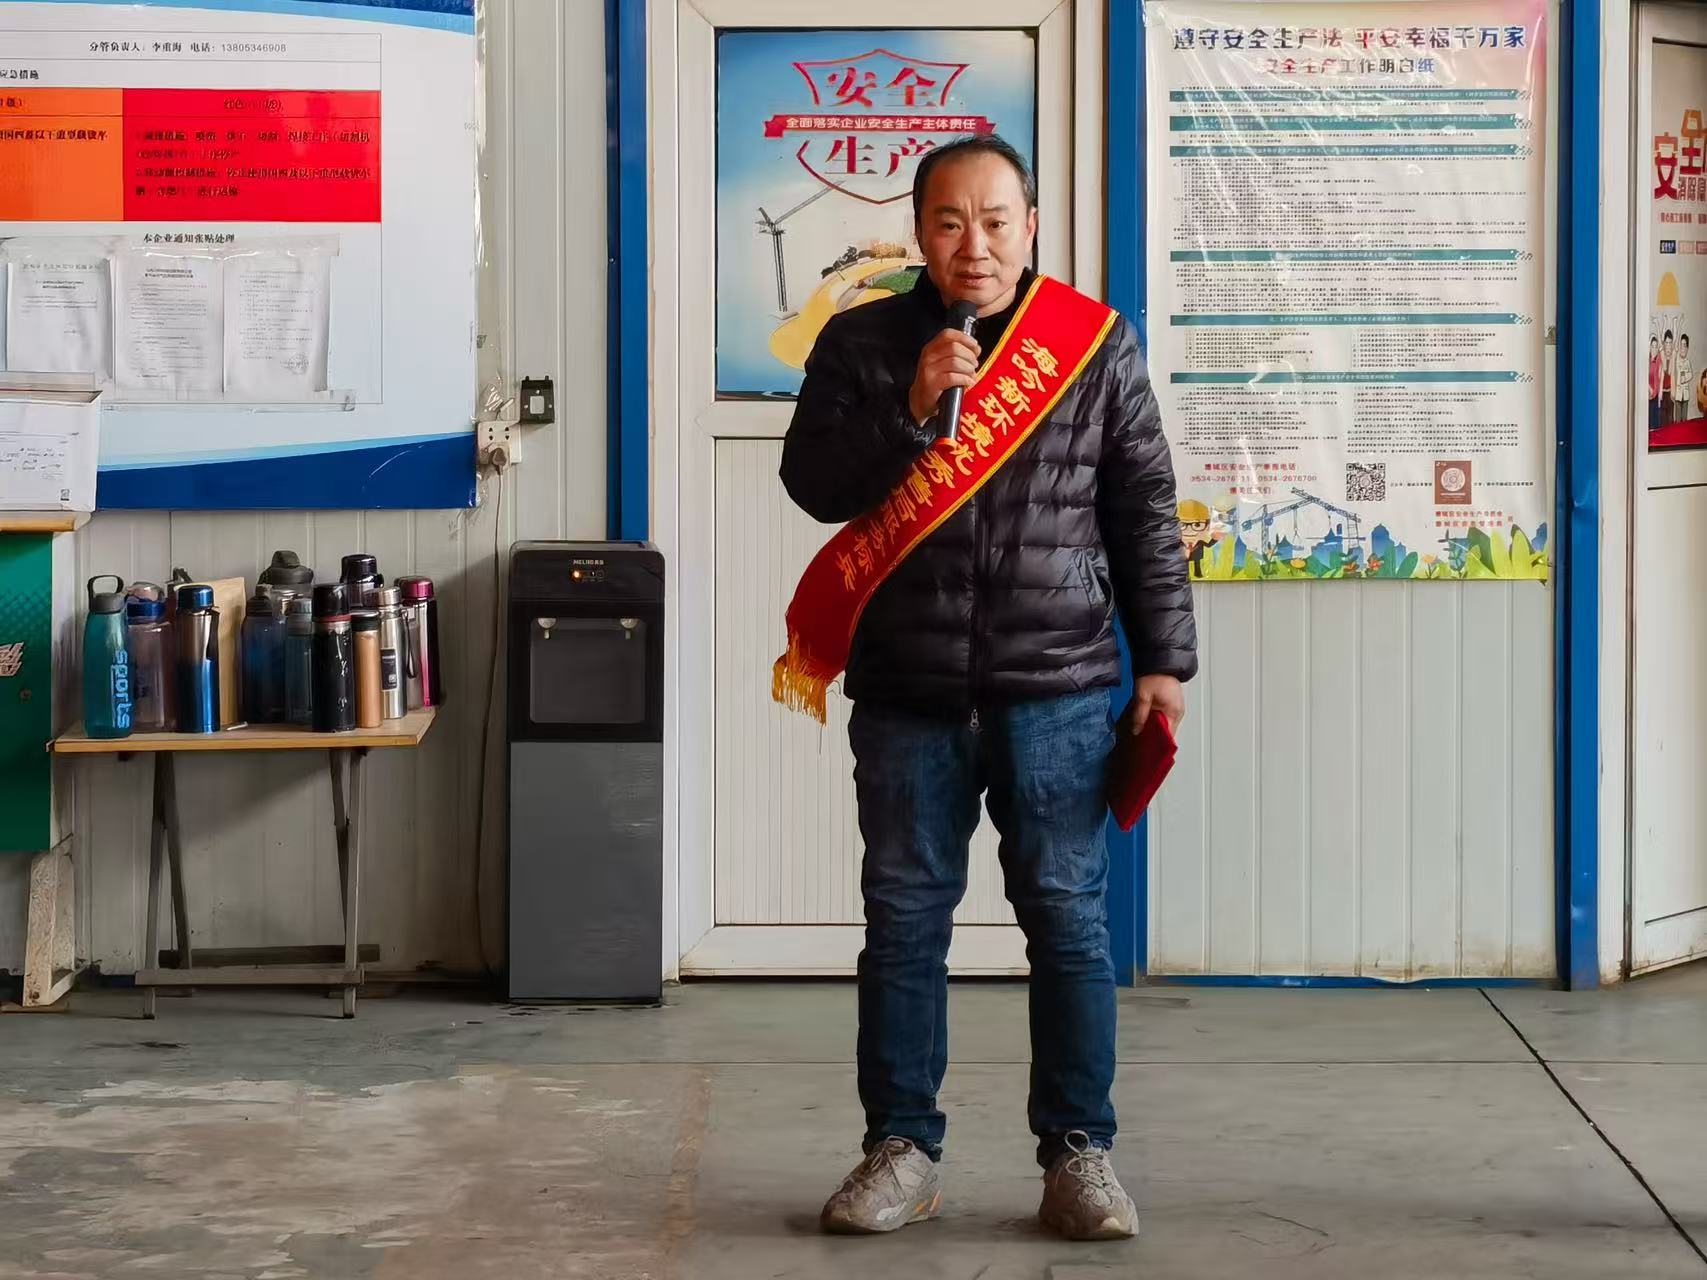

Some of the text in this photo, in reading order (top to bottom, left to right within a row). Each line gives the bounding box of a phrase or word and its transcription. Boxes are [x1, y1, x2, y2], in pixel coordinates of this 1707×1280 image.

[221, 43, 287, 53] 13805346908
[1173, 27, 1526, 51] 遵守安全生产法 平安幸福千万家
[827, 66, 938, 108] 安全
[785, 116, 977, 130] 全面落实企业安全生产主体责任
[143, 232, 236, 245] 本企业通知张贴处理
[111, 648, 132, 729] sports
